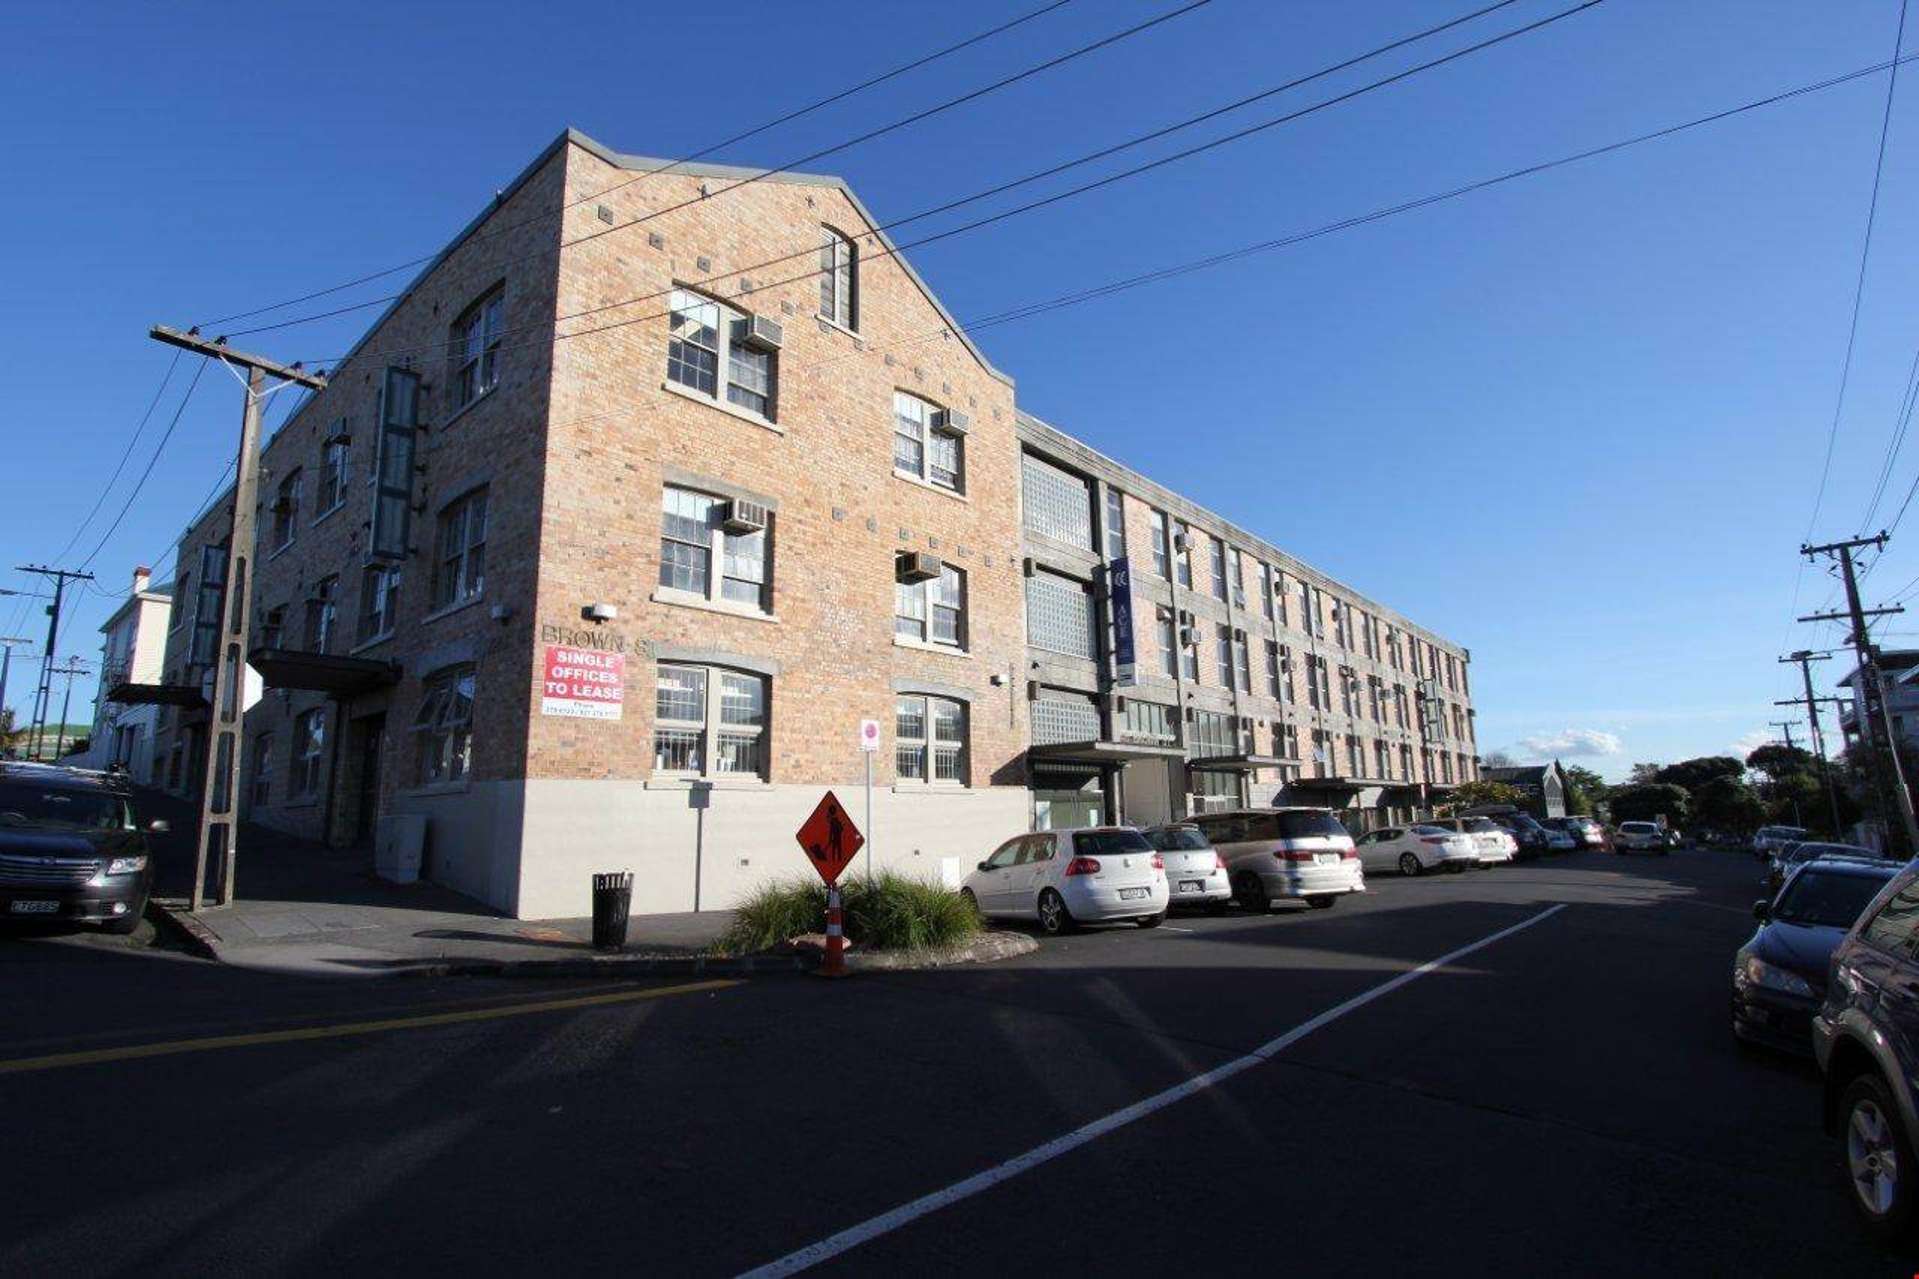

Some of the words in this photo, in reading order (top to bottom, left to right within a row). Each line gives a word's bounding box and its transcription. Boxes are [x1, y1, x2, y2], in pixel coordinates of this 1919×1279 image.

[542, 625, 624, 652] BROWN
[556, 650, 616, 668] SINGLE
[551, 666, 618, 683] OFFICES
[545, 682, 568, 695] TO
[572, 684, 624, 699] LEASE
